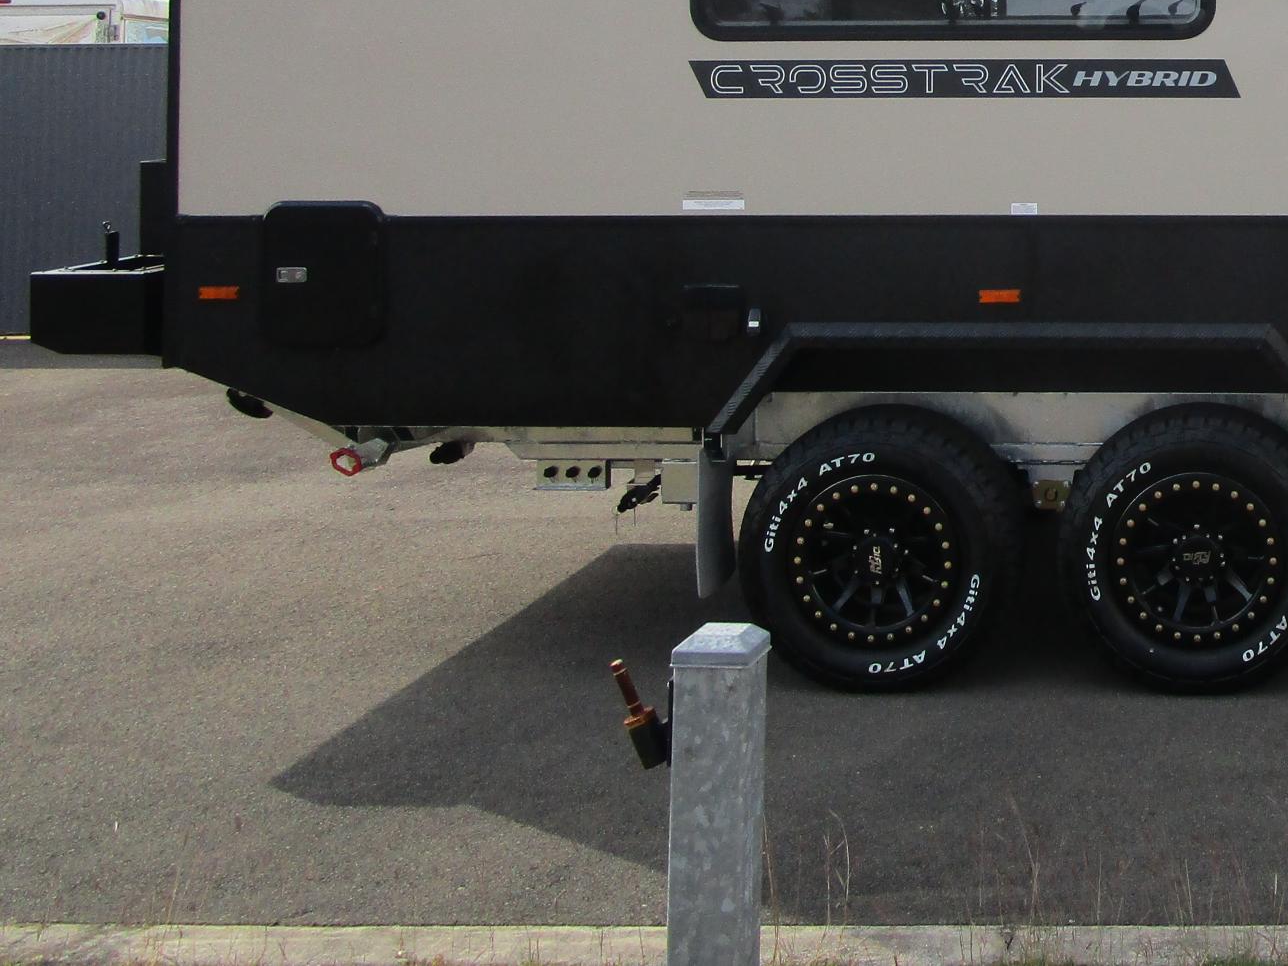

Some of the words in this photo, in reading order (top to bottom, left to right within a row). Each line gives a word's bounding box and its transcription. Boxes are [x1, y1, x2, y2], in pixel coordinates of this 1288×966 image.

[710, 63, 1070, 94] CROSSTRAK
[1072, 69, 1217, 87] HYBRID
[818, 452, 875, 476] AT70
[1106, 461, 1152, 508] AT70
[1242, 615, 1288, 663] AT70
[868, 649, 927, 674] AT70
